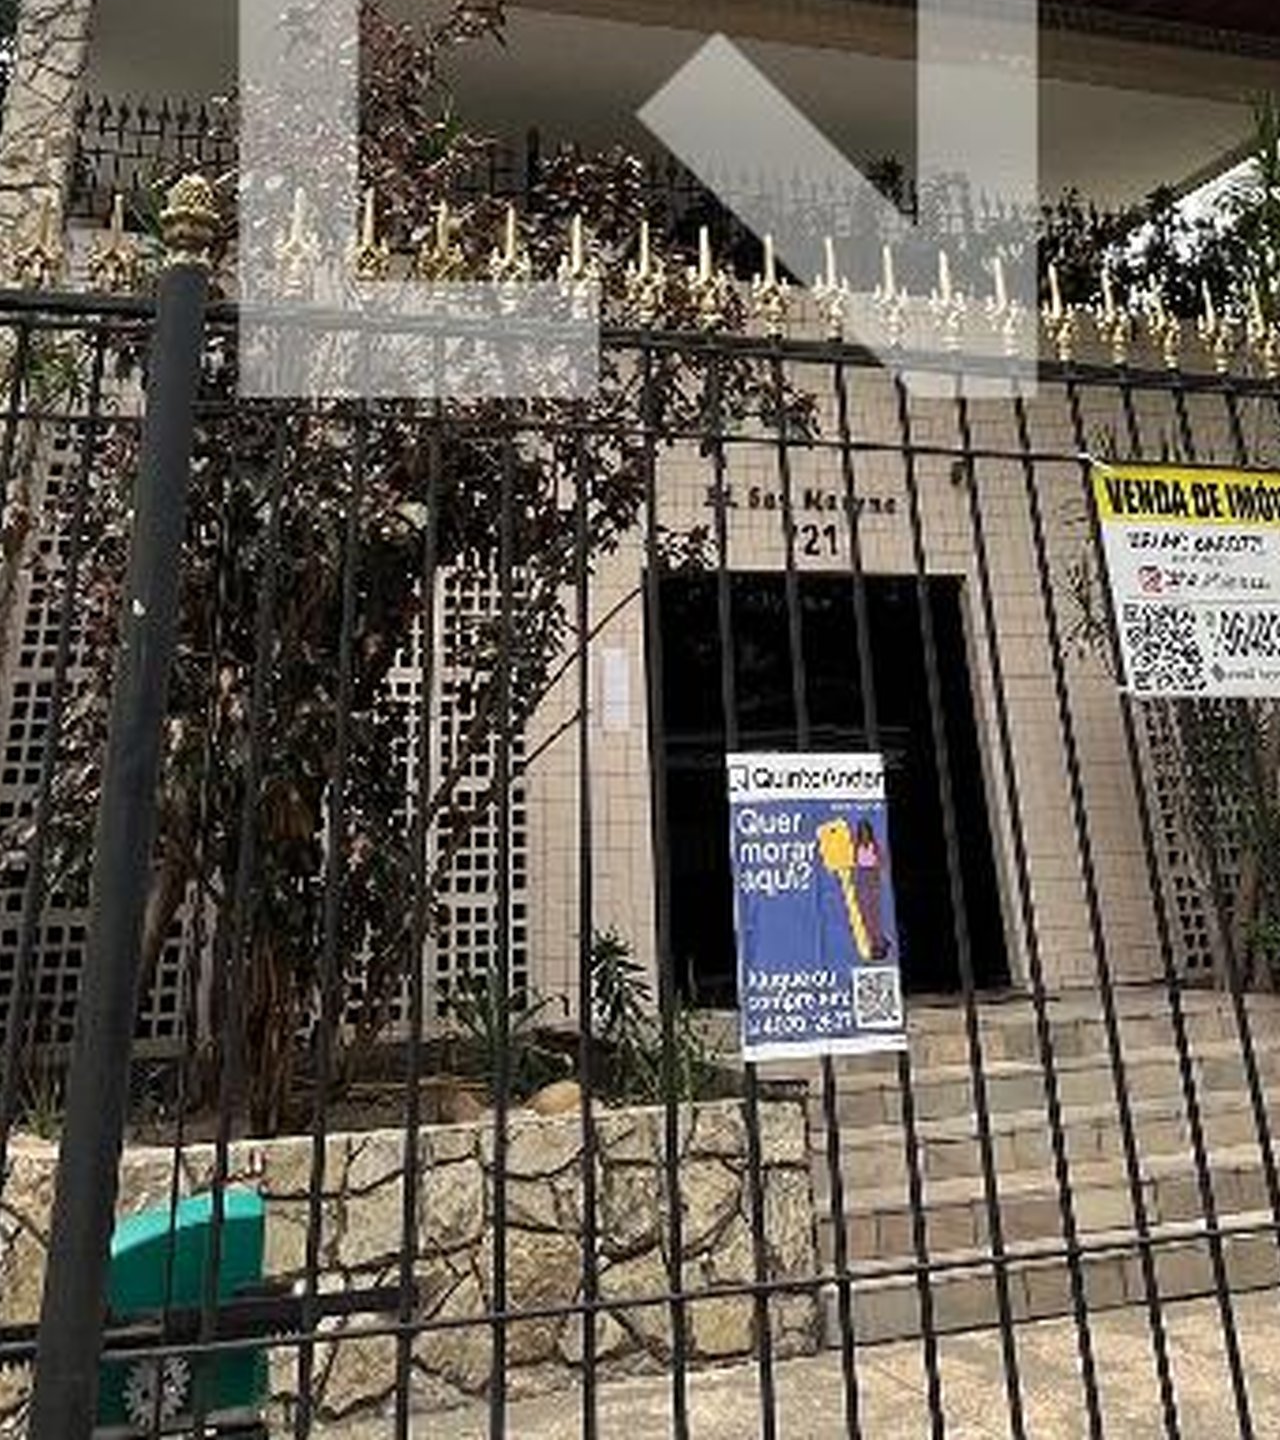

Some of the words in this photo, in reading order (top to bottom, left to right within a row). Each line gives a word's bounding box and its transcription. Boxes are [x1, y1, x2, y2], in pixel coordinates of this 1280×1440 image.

[1104, 477, 1190, 518] VENDA
[1191, 482, 1221, 518] DE
[752, 767, 884, 789] QuintoAndar
[737, 808, 802, 835] Quer
[740, 841, 816, 863] morar
[740, 861, 812, 896] aqui?
